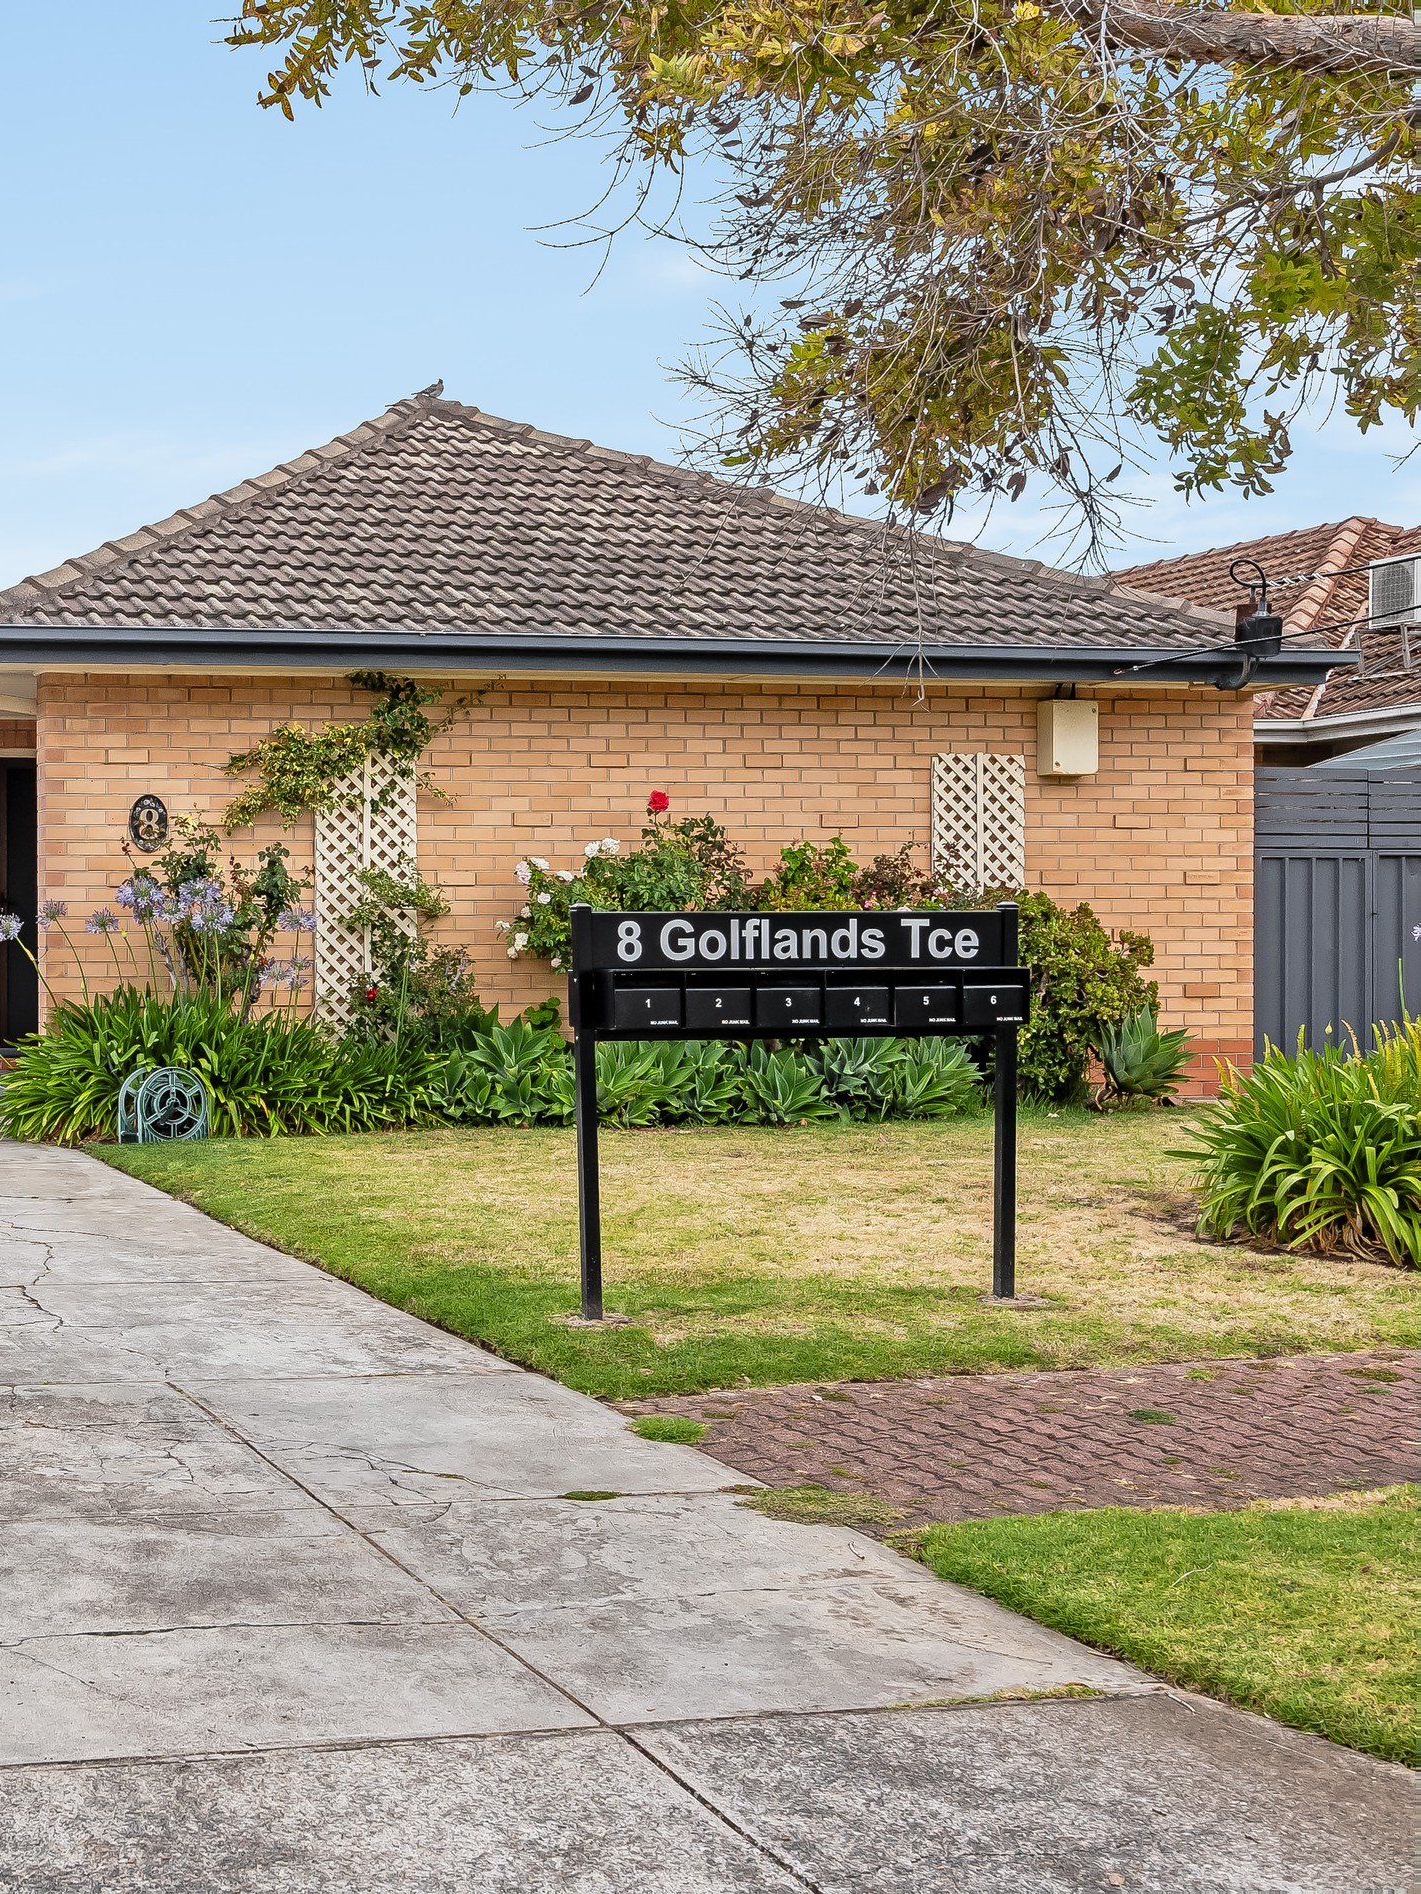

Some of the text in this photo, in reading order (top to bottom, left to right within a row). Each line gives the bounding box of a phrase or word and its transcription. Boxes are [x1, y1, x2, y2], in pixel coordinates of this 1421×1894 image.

[139, 808, 160, 840] 8
[617, 918, 980, 962] 8 Golflands Tce
[645, 998, 651, 1008] 1
[715, 998, 722, 1008] 2
[785, 997, 792, 1007] 3
[854, 997, 861, 1006] 4
[923, 996, 930, 1005] 5
[990, 995, 997, 1005] 6
